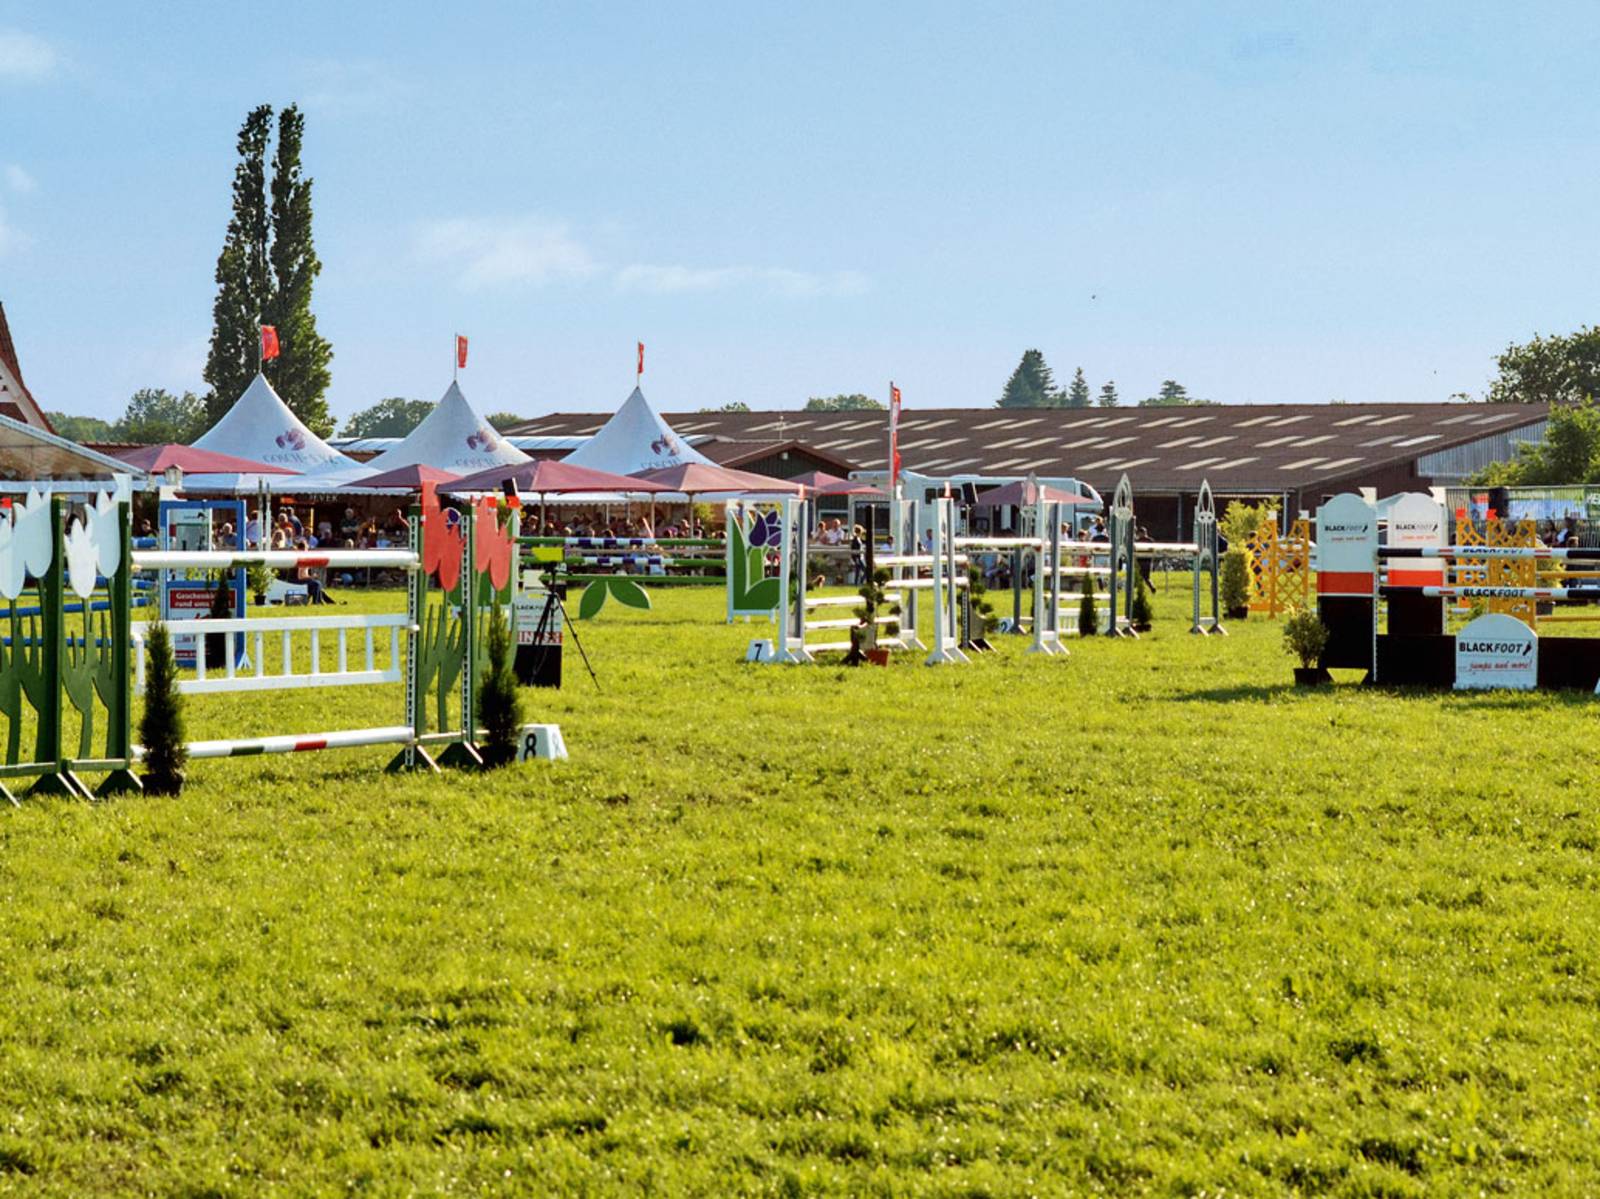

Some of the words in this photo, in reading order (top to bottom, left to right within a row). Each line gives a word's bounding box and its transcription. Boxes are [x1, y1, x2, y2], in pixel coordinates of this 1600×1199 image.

[1463, 588, 1526, 597] BLACKFOOT
[755, 643, 762, 661] 7
[1459, 642, 1522, 653] BLACKFOOT
[524, 733, 537, 762] 8
